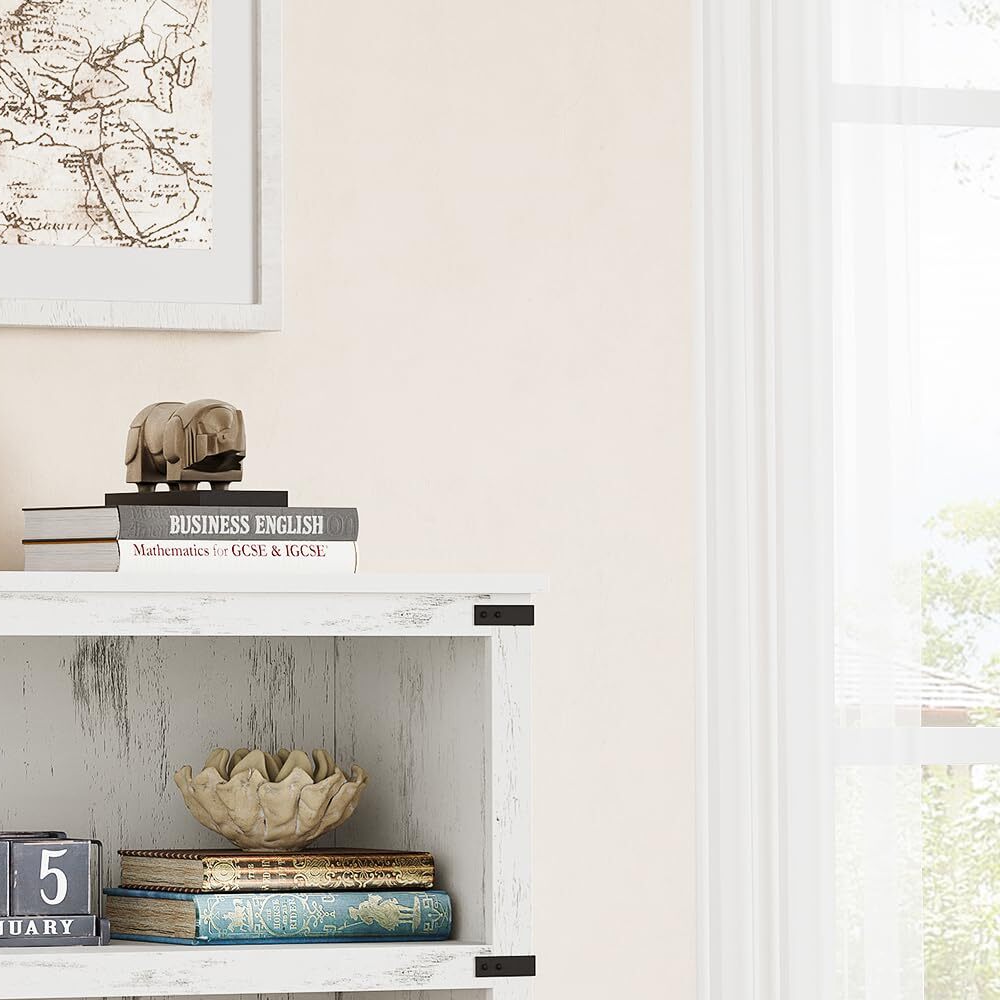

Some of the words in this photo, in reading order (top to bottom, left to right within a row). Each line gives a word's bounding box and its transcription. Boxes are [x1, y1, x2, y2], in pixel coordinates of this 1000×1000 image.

[169, 514, 250, 535] BUSINESS
[254, 514, 324, 535] ENGLISH
[133, 543, 210, 557] Mathematics
[212, 543, 229, 557] for
[231, 543, 268, 557] GCSE
[271, 543, 282, 557] &
[39, 848, 69, 906] 5
